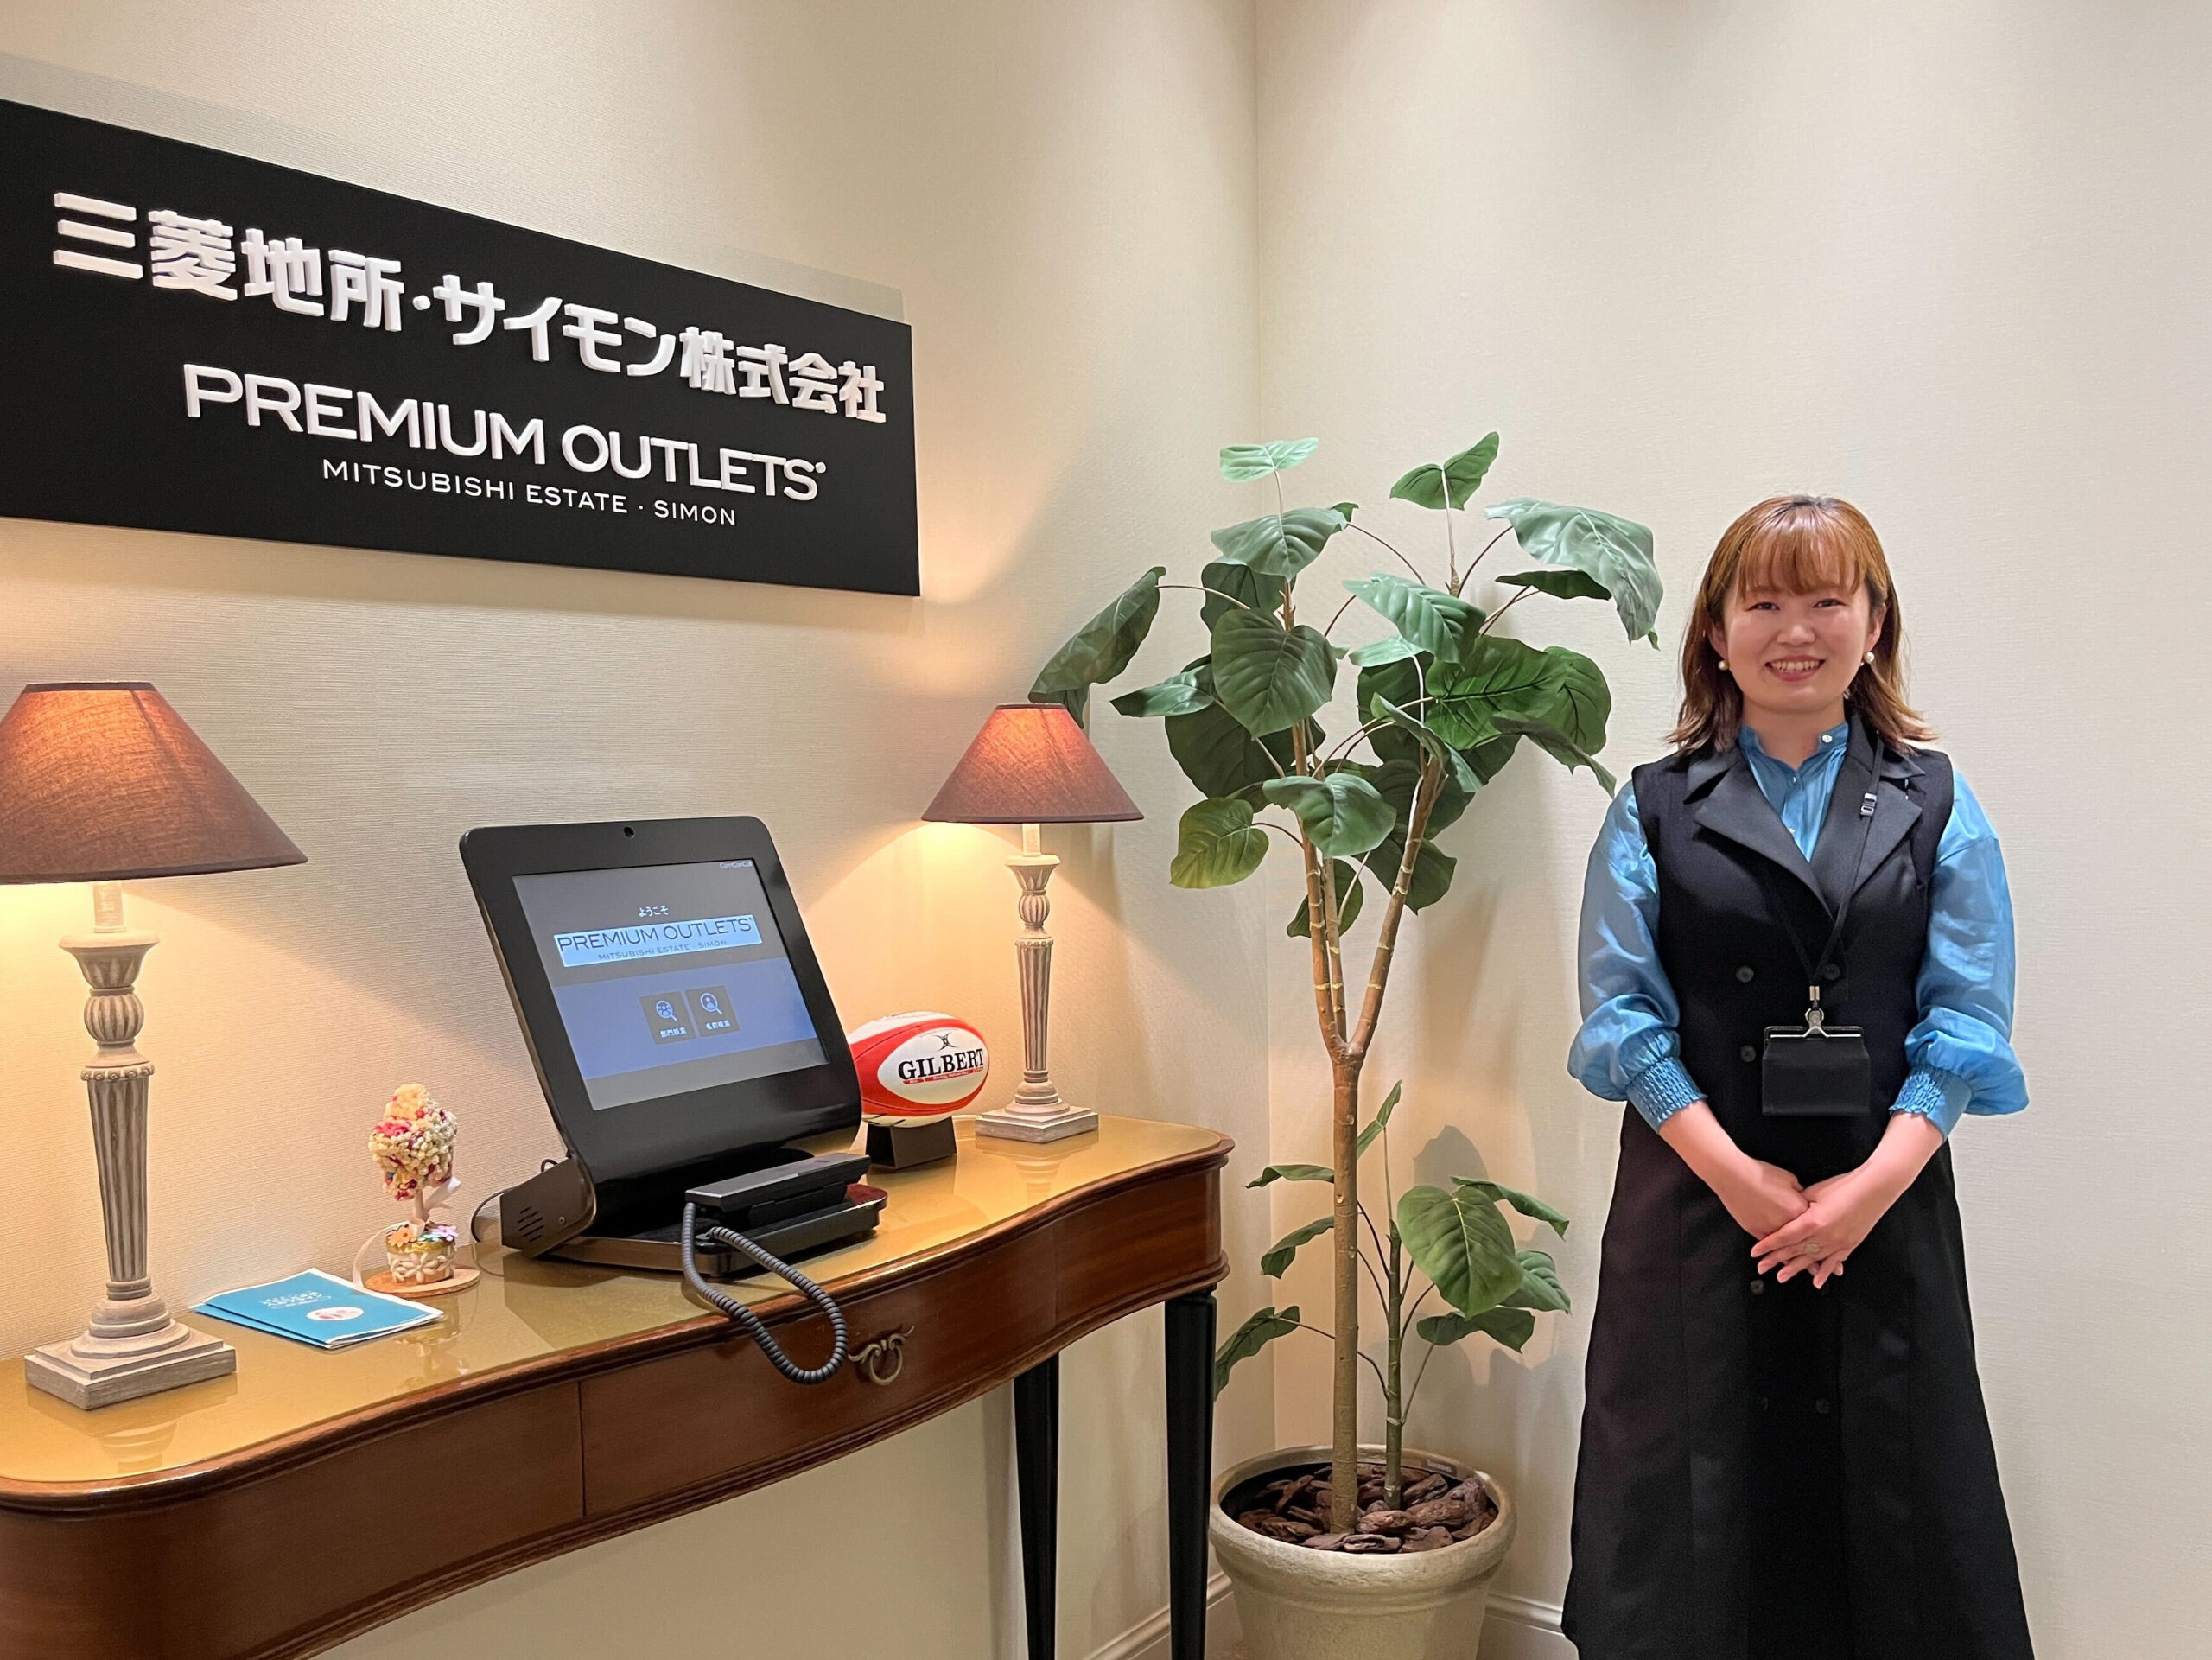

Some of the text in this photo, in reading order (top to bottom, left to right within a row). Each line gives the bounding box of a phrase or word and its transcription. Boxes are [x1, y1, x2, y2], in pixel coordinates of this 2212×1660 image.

[184, 364, 546, 465] PREMIUM
[323, 460, 514, 503] MITSUBISHI
[527, 485, 628, 514] ESTATE
[655, 500, 736, 526] SIMON
[639, 905, 669, 917] ようこそ
[557, 927, 658, 952] PREMIUM
[598, 939, 728, 961] MITSUBISHI ESTATE SIMON
[898, 1048, 984, 1080] GILBERT
